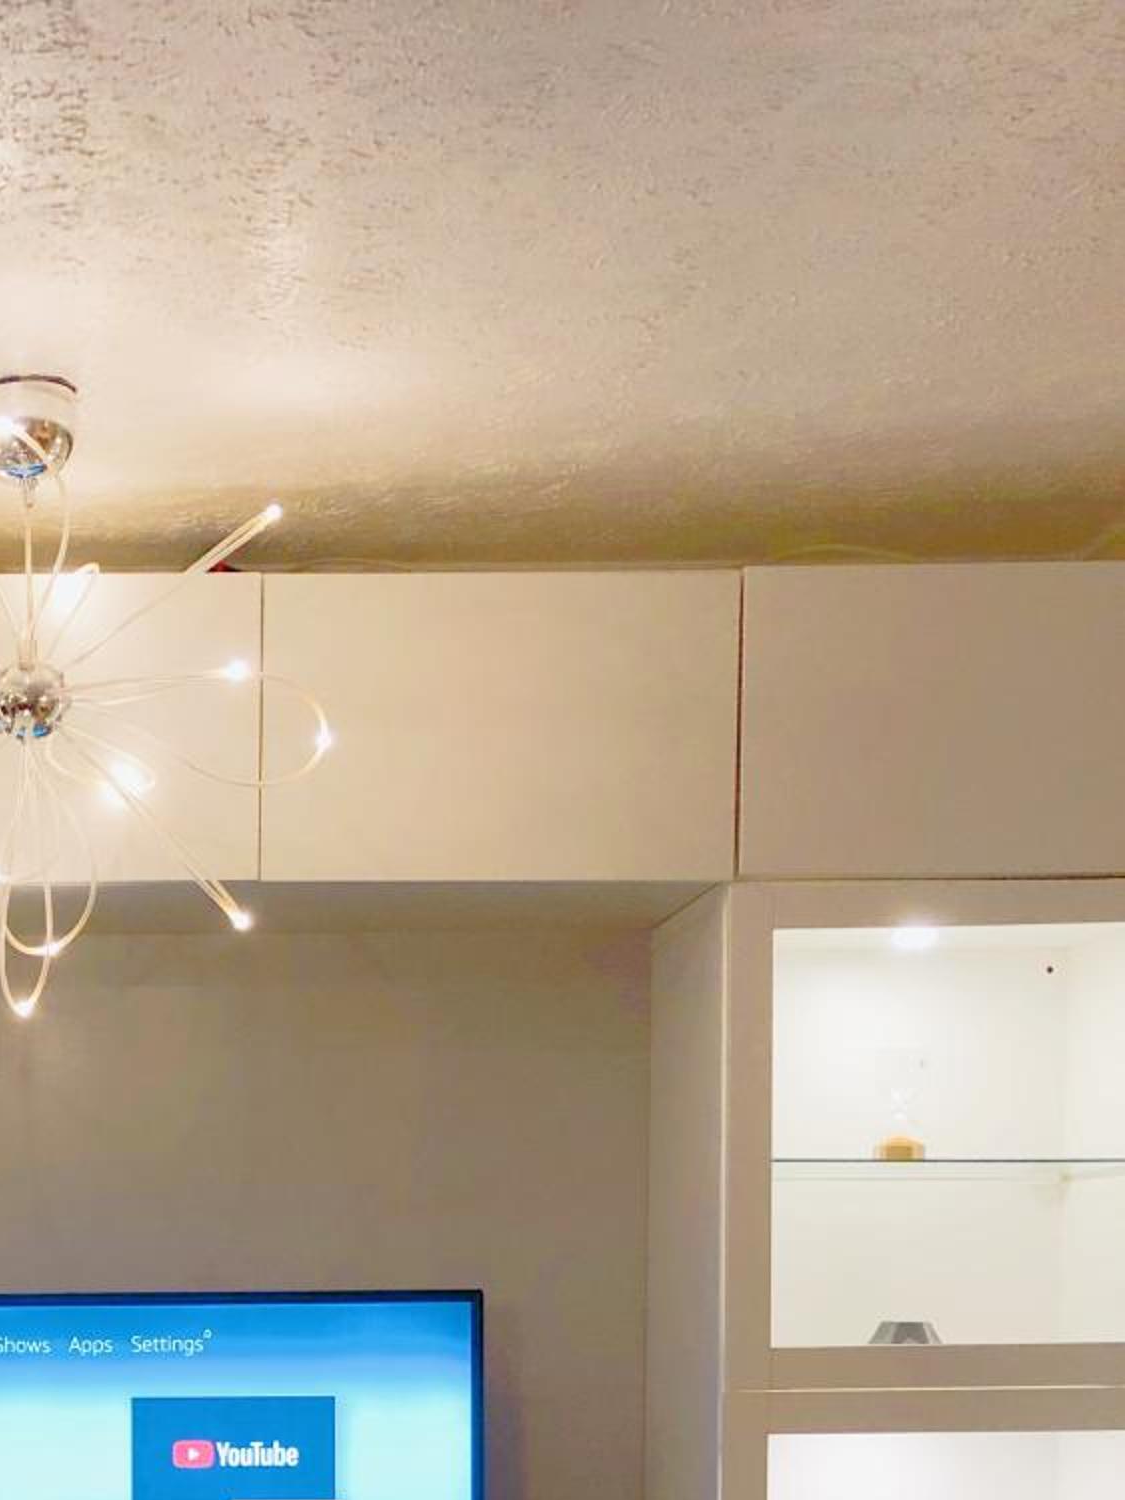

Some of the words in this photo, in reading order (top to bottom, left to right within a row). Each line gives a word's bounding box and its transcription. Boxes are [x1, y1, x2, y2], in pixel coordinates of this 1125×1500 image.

[68, 1337, 113, 1354] Apps
[131, 1335, 204, 1355] Settings
[216, 1441, 299, 1467] YouTube
